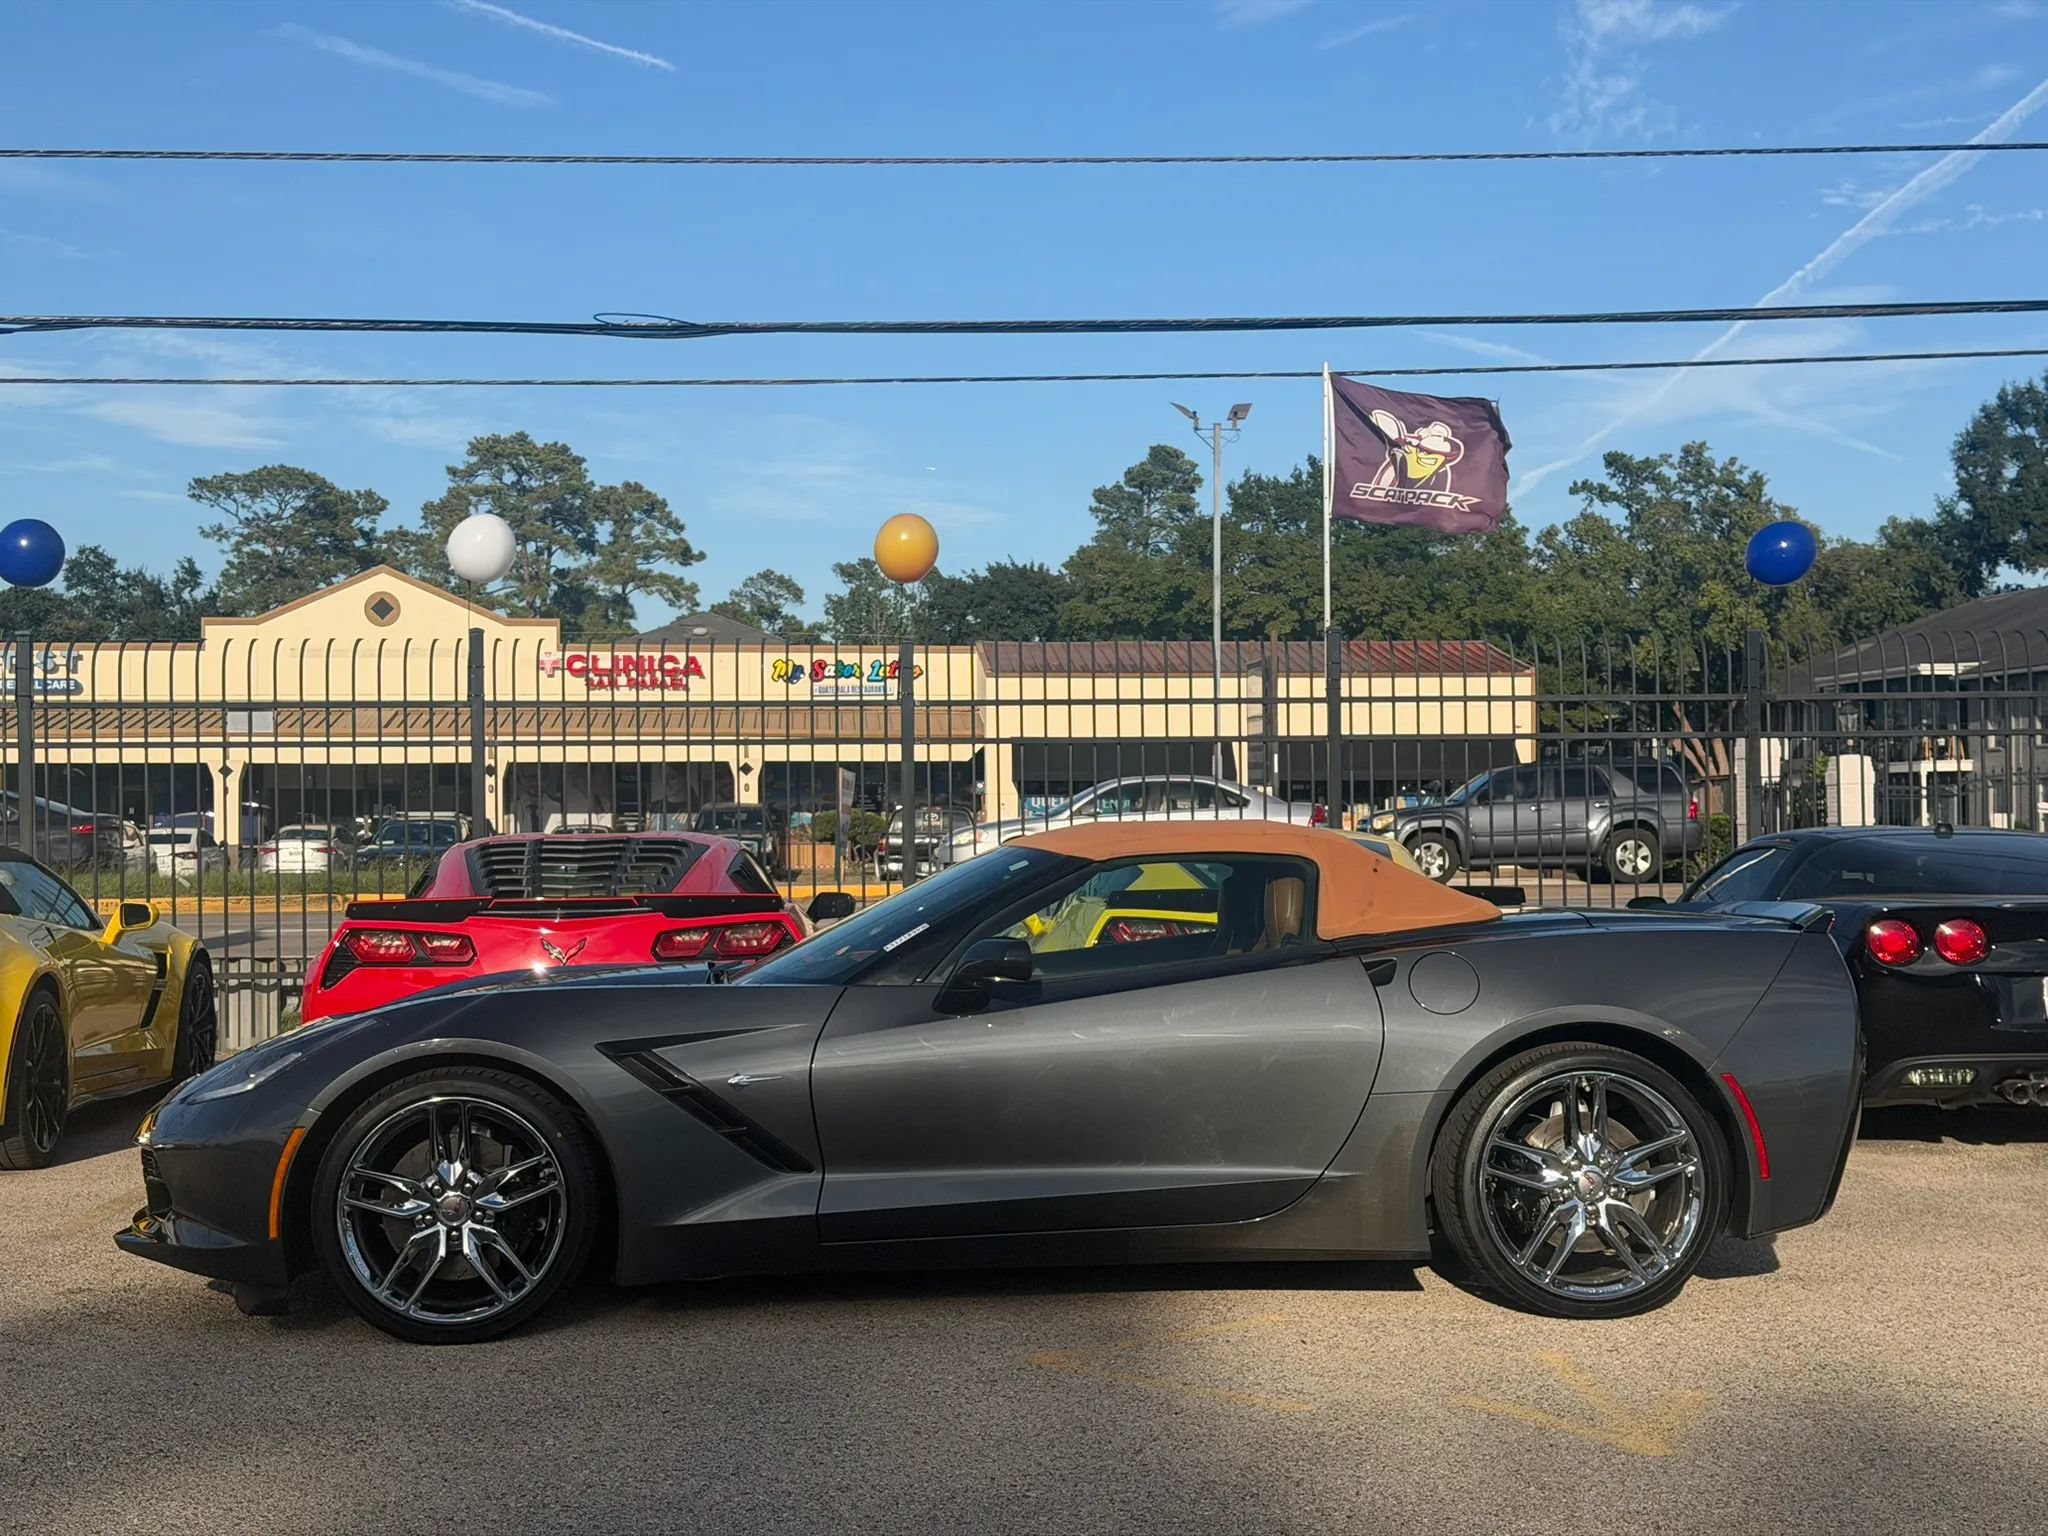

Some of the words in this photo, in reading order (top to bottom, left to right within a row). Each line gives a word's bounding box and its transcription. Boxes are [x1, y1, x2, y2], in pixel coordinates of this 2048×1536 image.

[566, 653, 706, 678] CLINICA
[809, 659, 863, 682] Sabor
[867, 659, 923, 682] Lato
